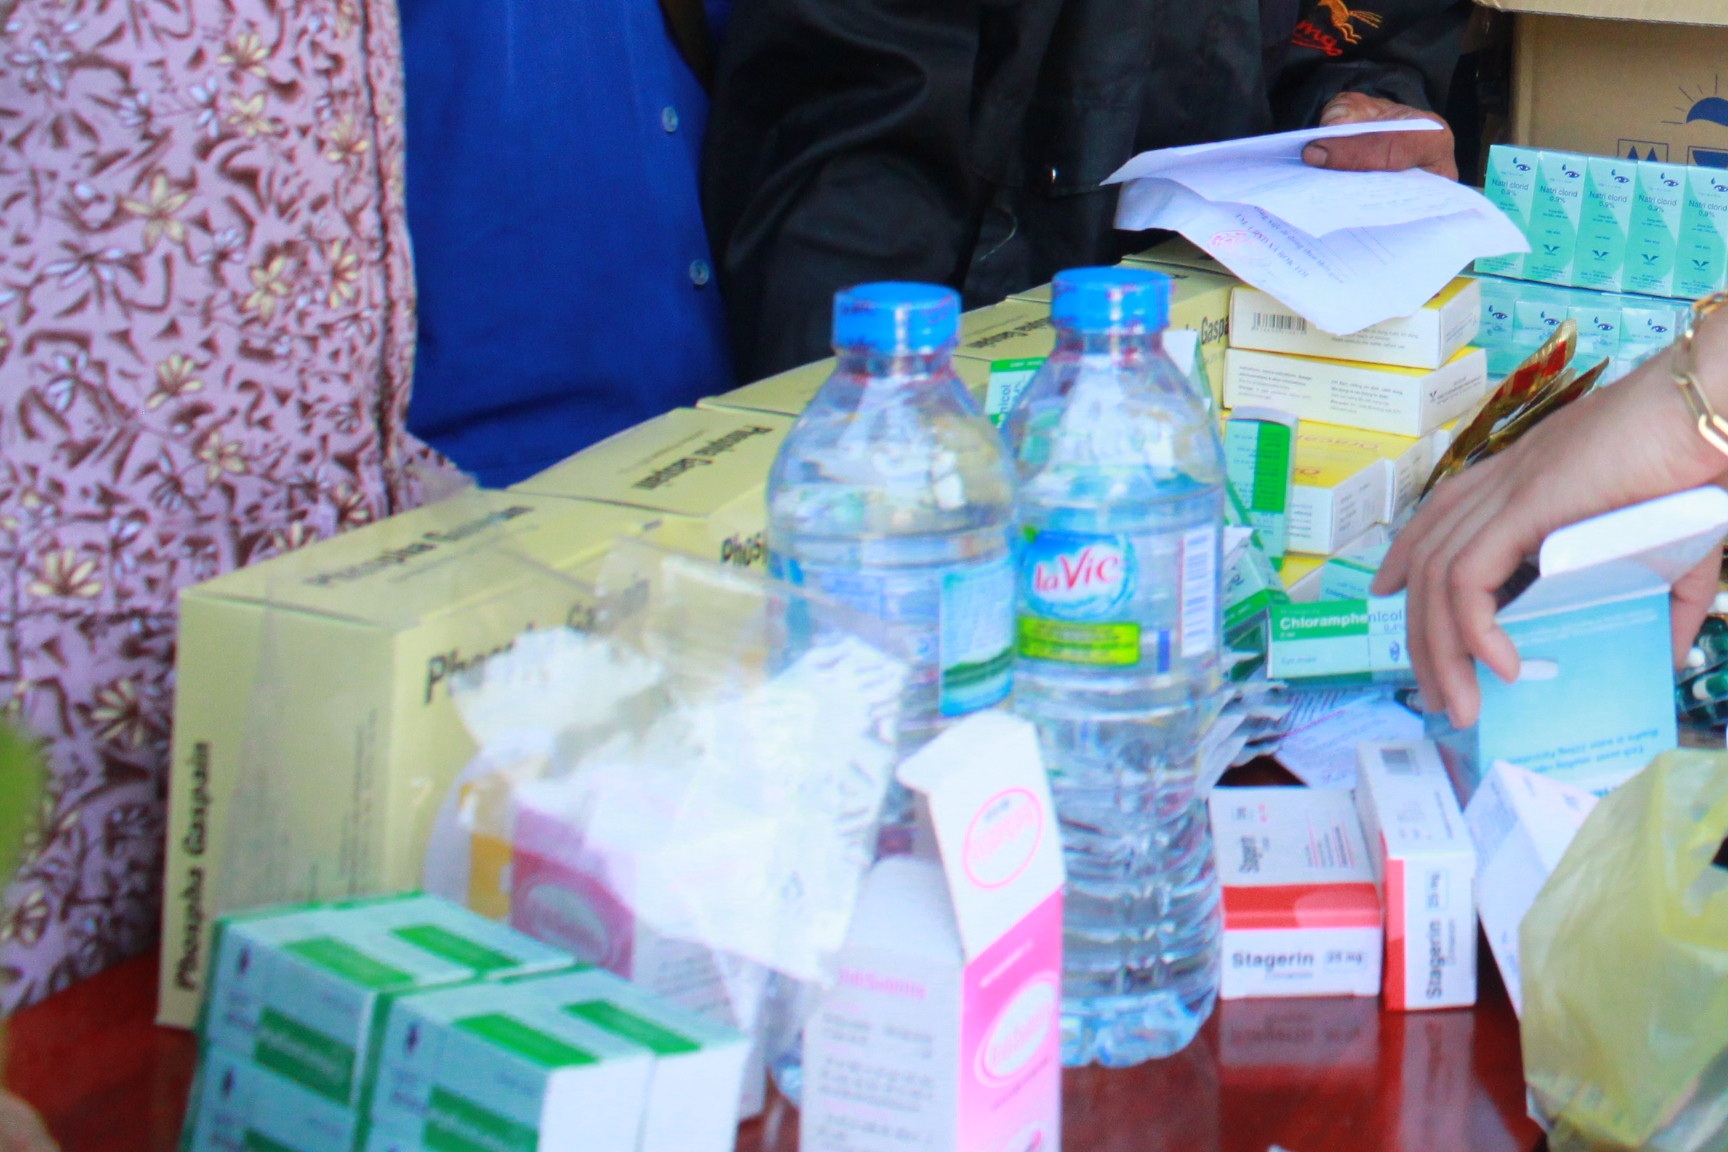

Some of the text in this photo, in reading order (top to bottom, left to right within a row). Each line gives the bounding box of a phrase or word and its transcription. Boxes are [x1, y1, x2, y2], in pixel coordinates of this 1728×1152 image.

[1492, 178, 1529, 191] Natri clorid
[1540, 184, 1578, 198] Natri clorid
[1589, 190, 1627, 203] Natri clorid
[1638, 194, 1677, 207] Natri clorid
[1688, 199, 1728, 212] Natri clorid
[1280, 609, 1402, 631] Chloramphenicol
[1232, 952, 1314, 971] Stagerin
[1427, 920, 1446, 999] Stagerin
